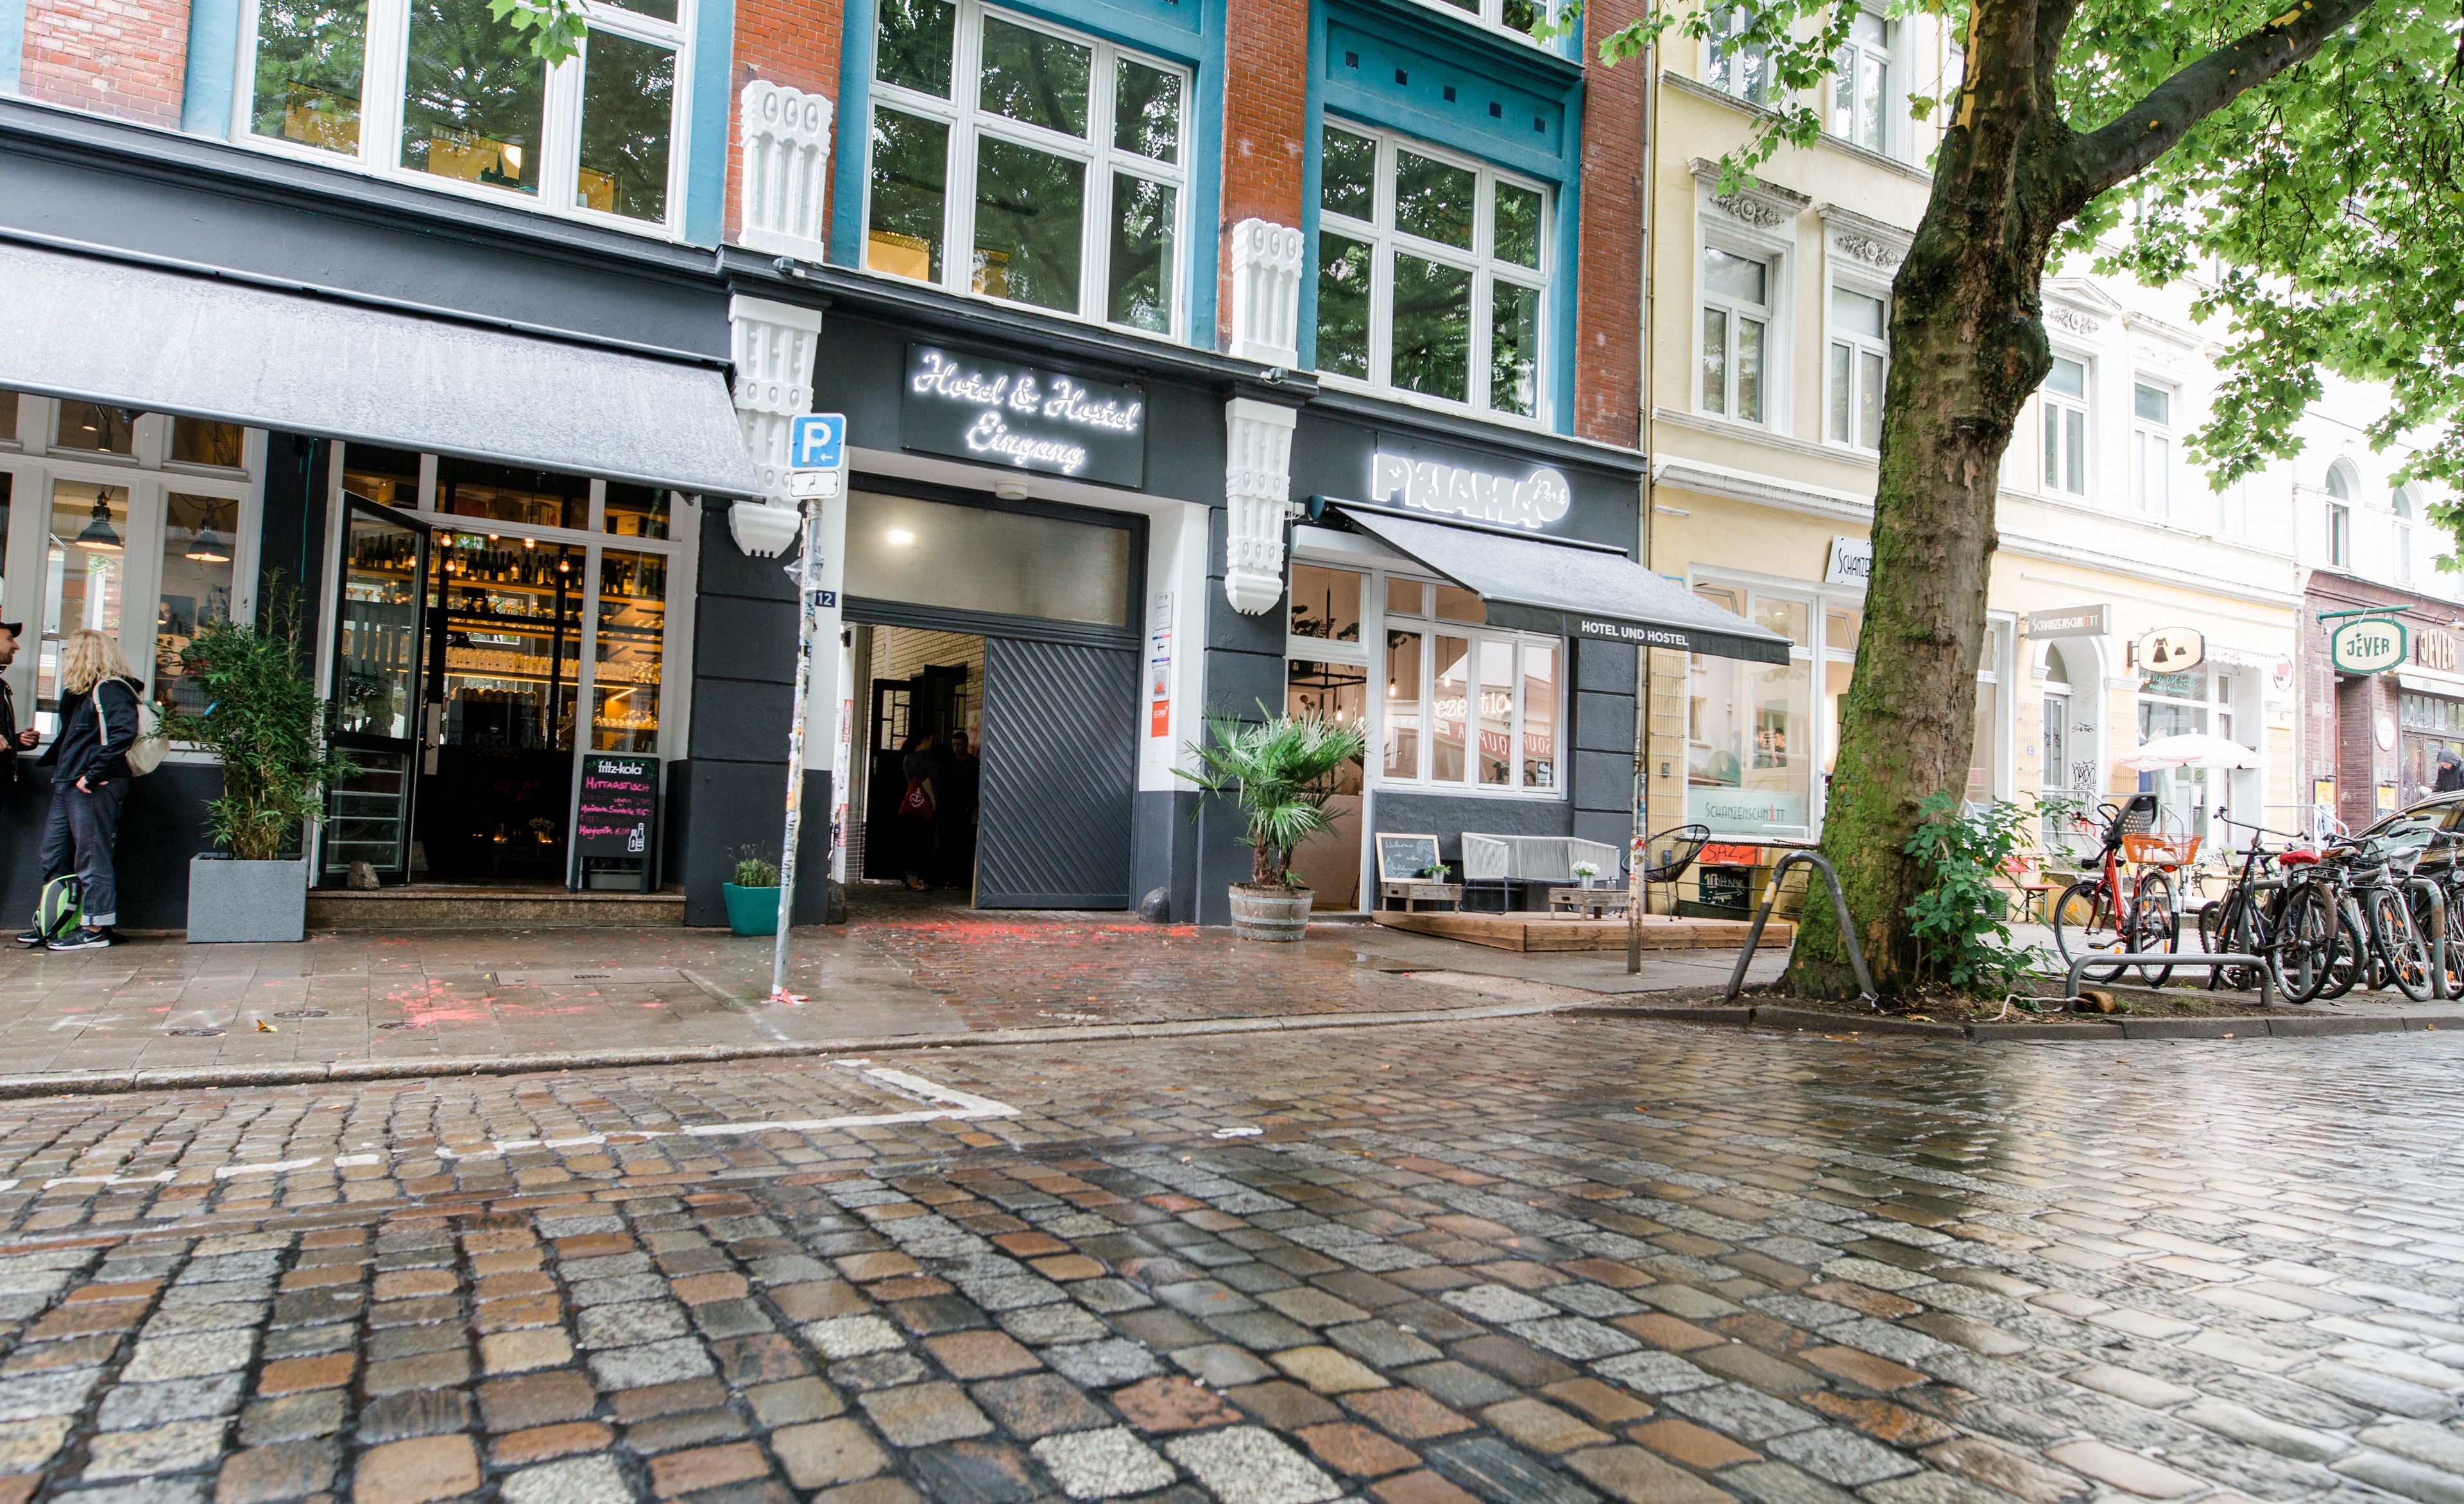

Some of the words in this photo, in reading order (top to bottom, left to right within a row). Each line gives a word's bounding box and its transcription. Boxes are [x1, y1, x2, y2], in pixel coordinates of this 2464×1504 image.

[914, 353, 1009, 407] Hotel
[1010, 376, 1041, 414] &
[1044, 379, 1142, 432] Hostel
[802, 422, 832, 463] P
[967, 411, 1087, 474] Eingang
[1838, 547, 1871, 577] SCHANZE
[817, 591, 832, 606] 12
[1582, 620, 1619, 637] HOTEL
[1621, 626, 1645, 640] UND
[1647, 630, 1689, 645] HOSTEL
[2347, 637, 2390, 658] JEVER
[2420, 629, 2454, 669] JEVER
